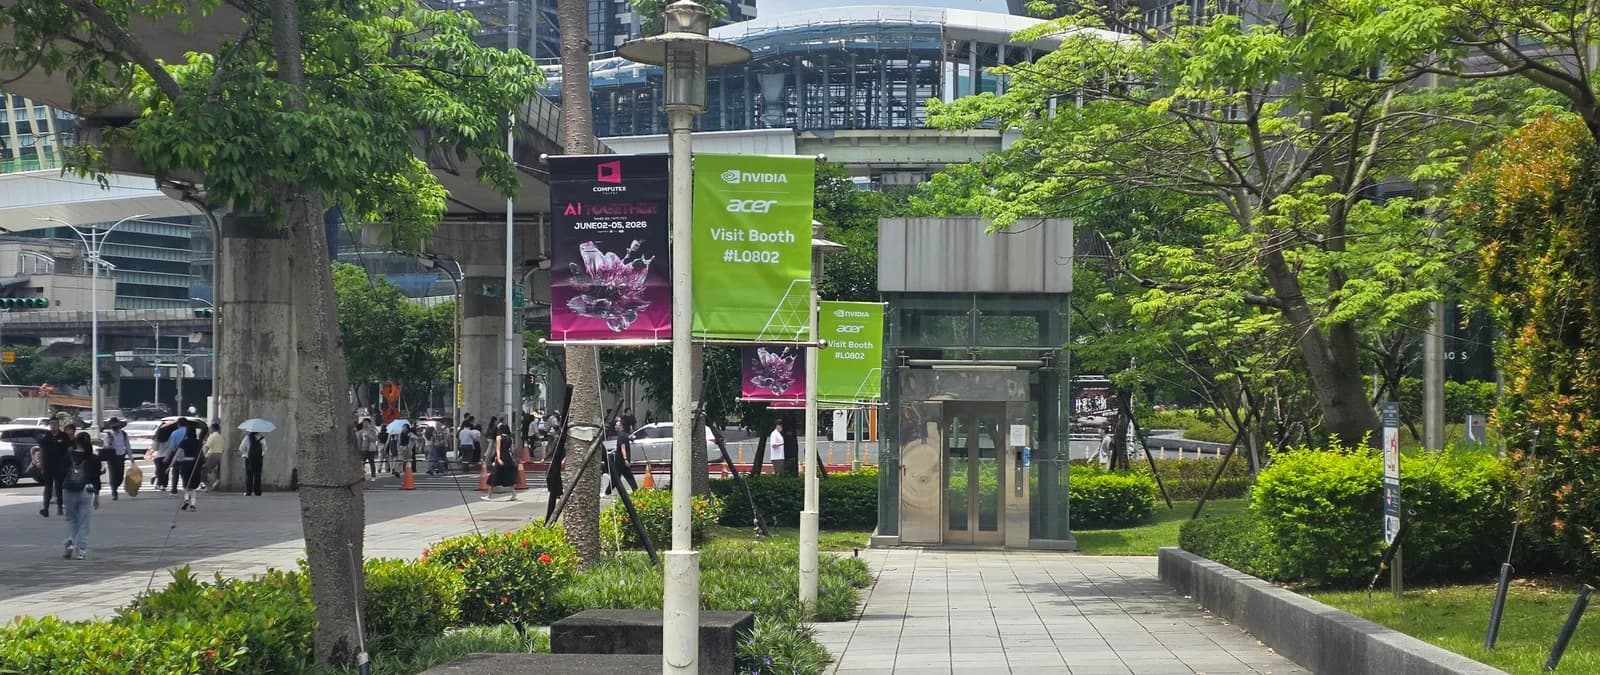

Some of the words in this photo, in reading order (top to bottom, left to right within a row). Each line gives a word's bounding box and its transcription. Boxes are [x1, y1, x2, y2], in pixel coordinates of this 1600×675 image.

[742, 172, 788, 184] NVIDIA
[564, 201, 582, 216] AI
[584, 202, 657, 216] TOGETHER
[726, 198, 778, 214] acer
[625, 221, 647, 229] 2026
[710, 228, 745, 241] Visit
[749, 229, 795, 243] Booth
[723, 249, 780, 264] #L0802
[845, 310, 870, 318] NVIDIA
[836, 324, 865, 334] acer
[827, 340, 846, 348] Visit
[848, 341, 873, 349] Booth
[835, 351, 865, 360] #L0802
